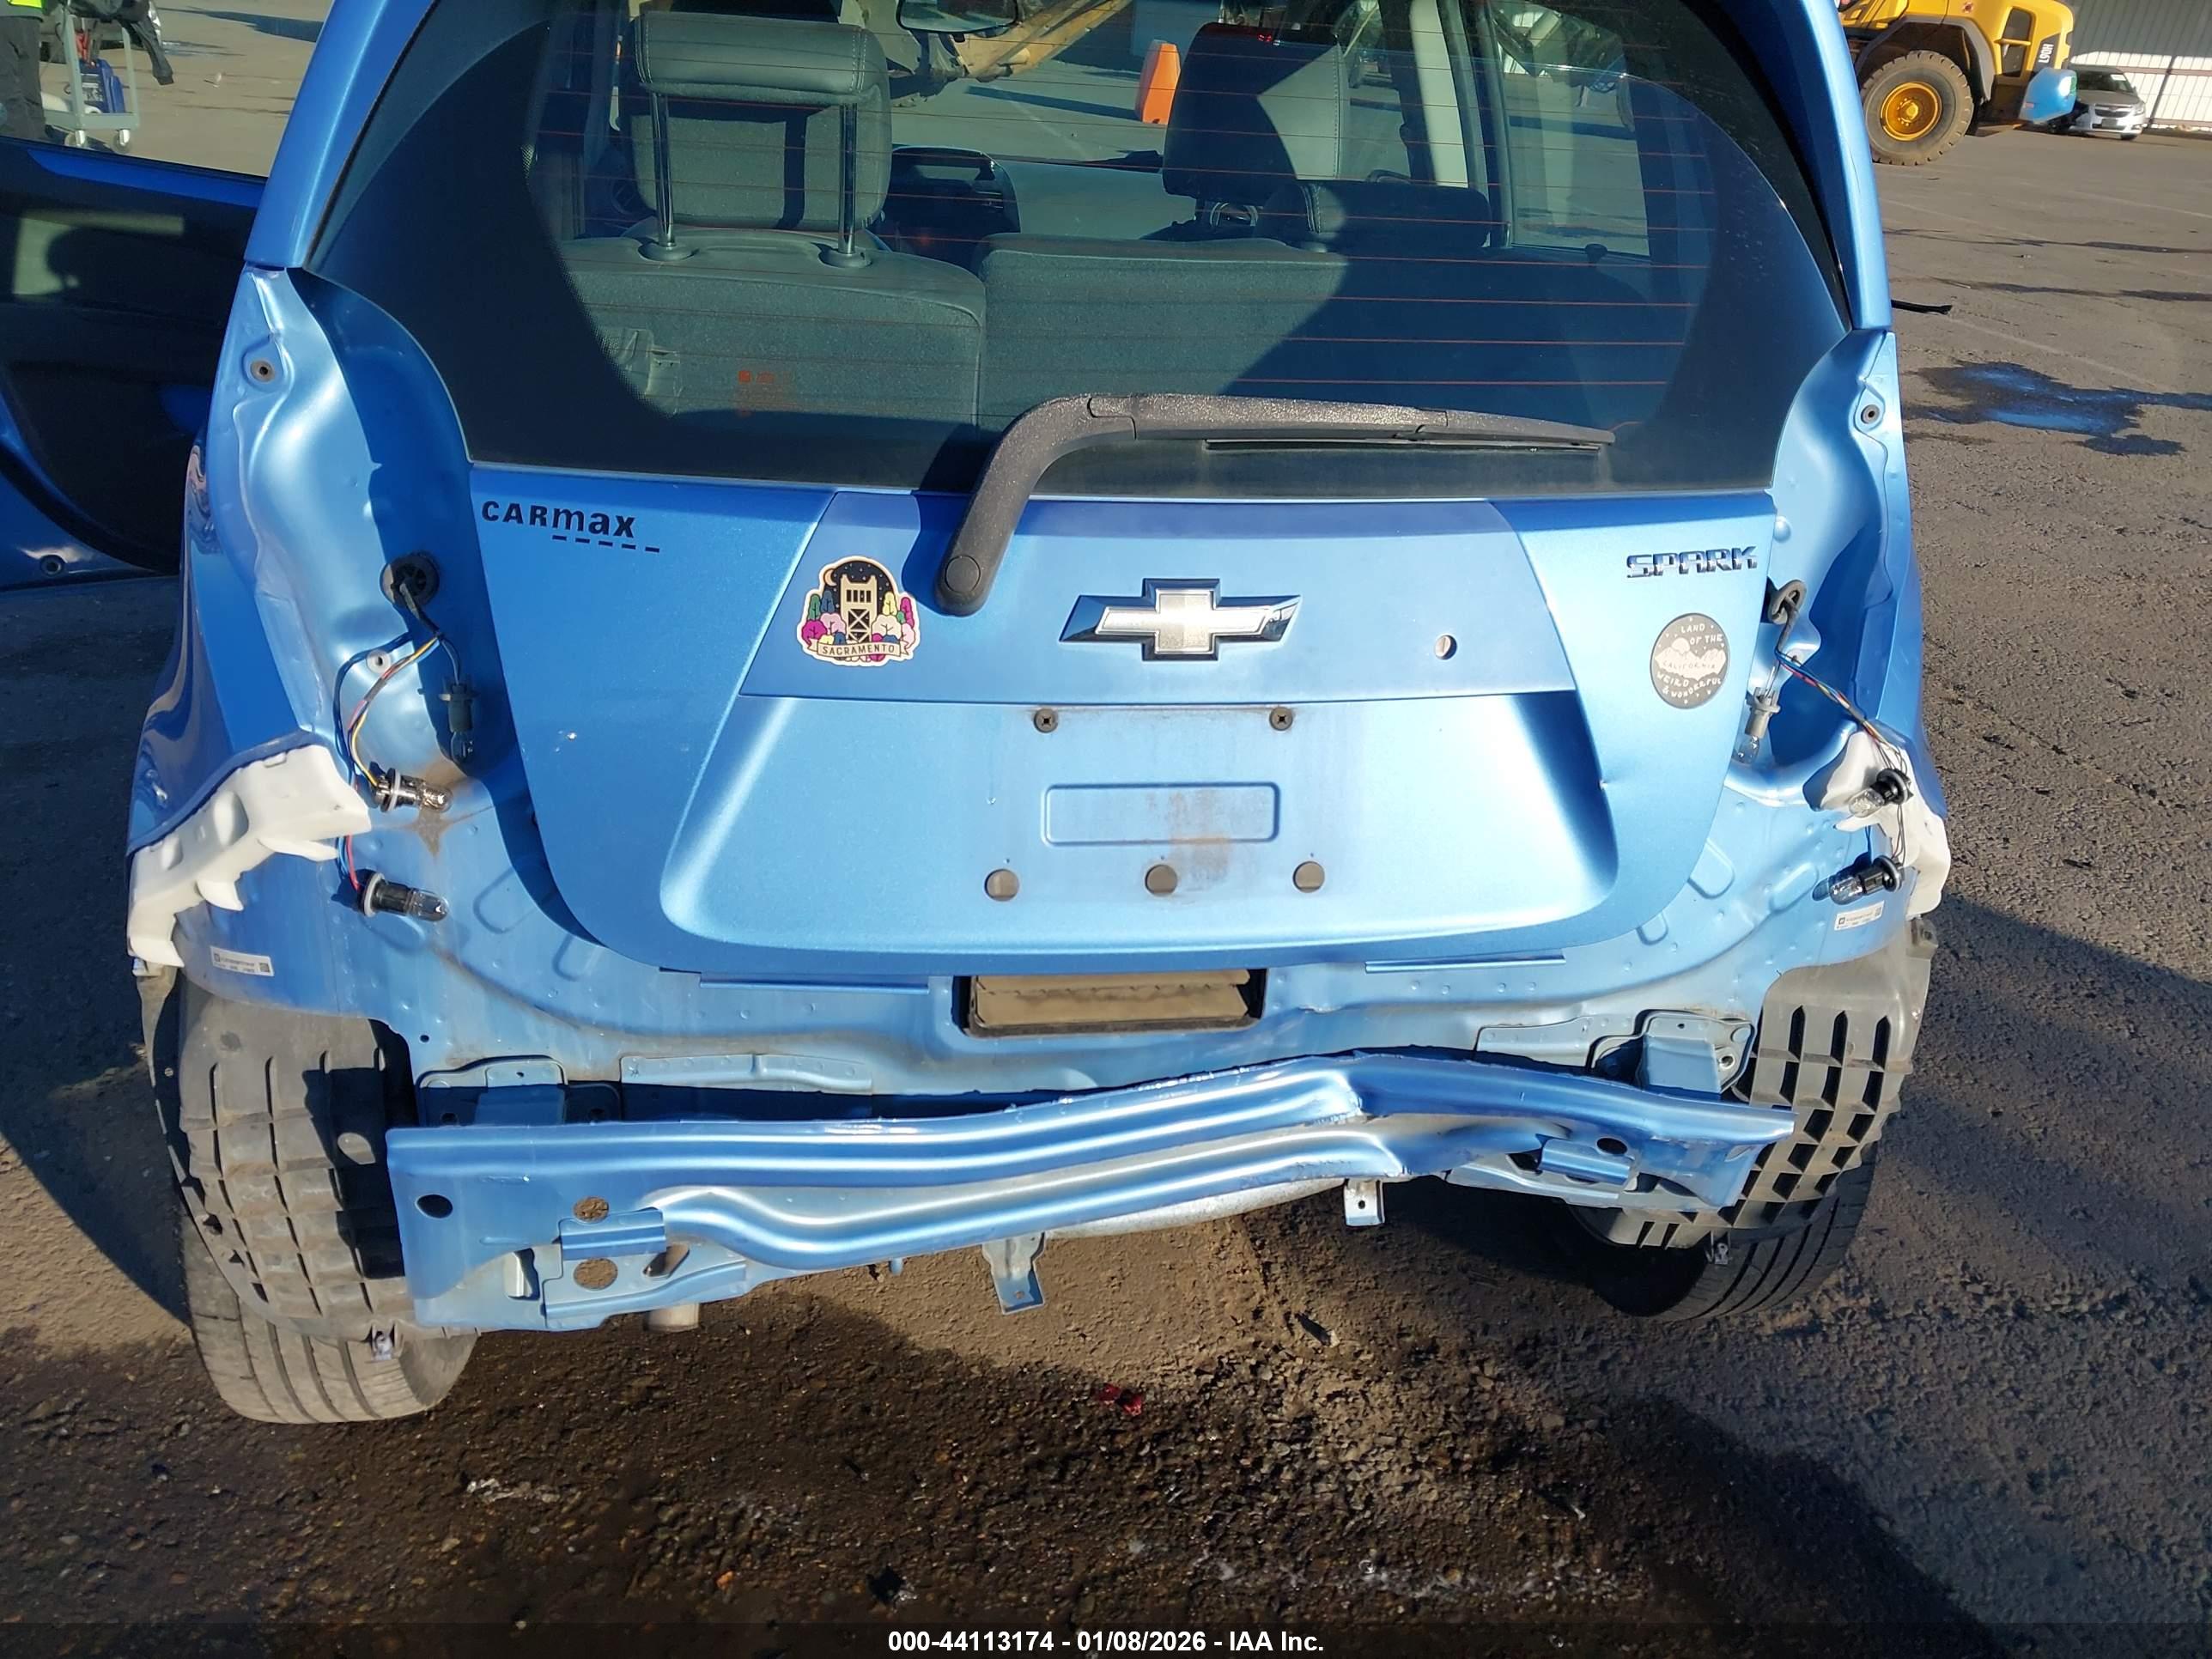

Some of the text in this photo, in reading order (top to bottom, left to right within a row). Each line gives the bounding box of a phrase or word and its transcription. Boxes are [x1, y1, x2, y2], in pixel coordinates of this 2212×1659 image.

[2038, 43, 2054, 64] L90H
[482, 500, 636, 538] CARmax
[1626, 545, 1758, 579] SPARK
[1680, 623, 1705, 634] LAND
[1689, 634, 1723, 645] OF THE
[822, 644, 895, 655] SACRAMENTO
[1656, 671, 1690, 688] WEIRD
[1662, 678, 1722, 699] & WONDERFUL
